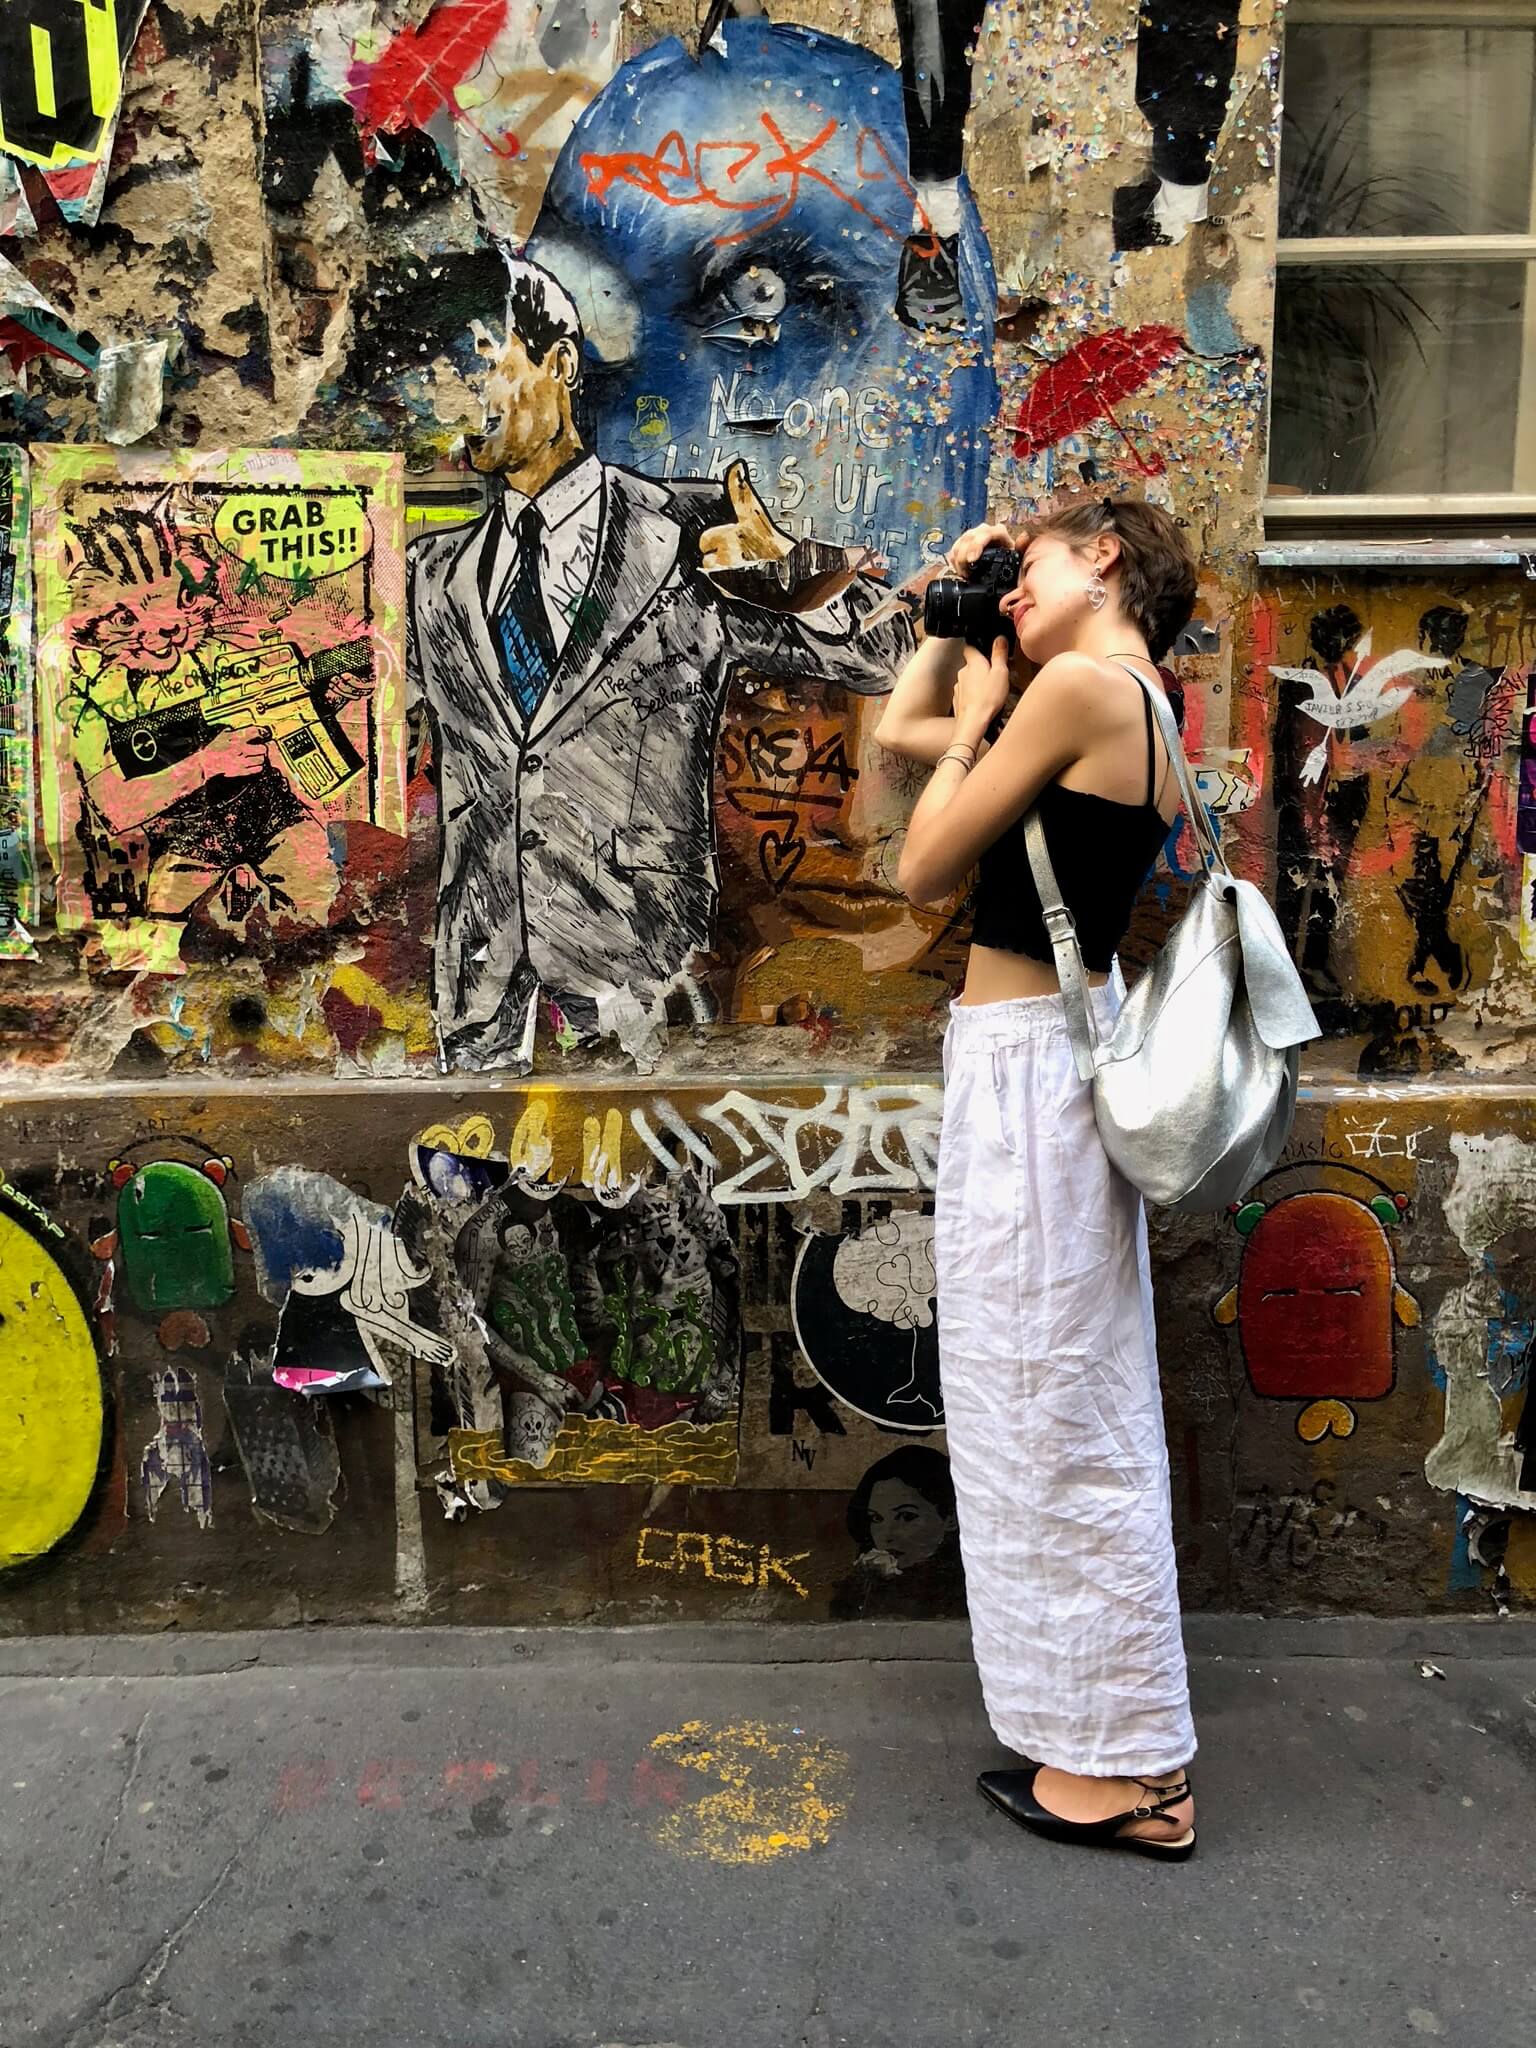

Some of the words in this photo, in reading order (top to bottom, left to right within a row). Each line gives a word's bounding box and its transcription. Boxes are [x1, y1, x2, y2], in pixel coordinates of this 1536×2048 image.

[232, 501, 326, 536] GRAB
[261, 527, 357, 563] THIS!!
[594, 675, 631, 700] The
